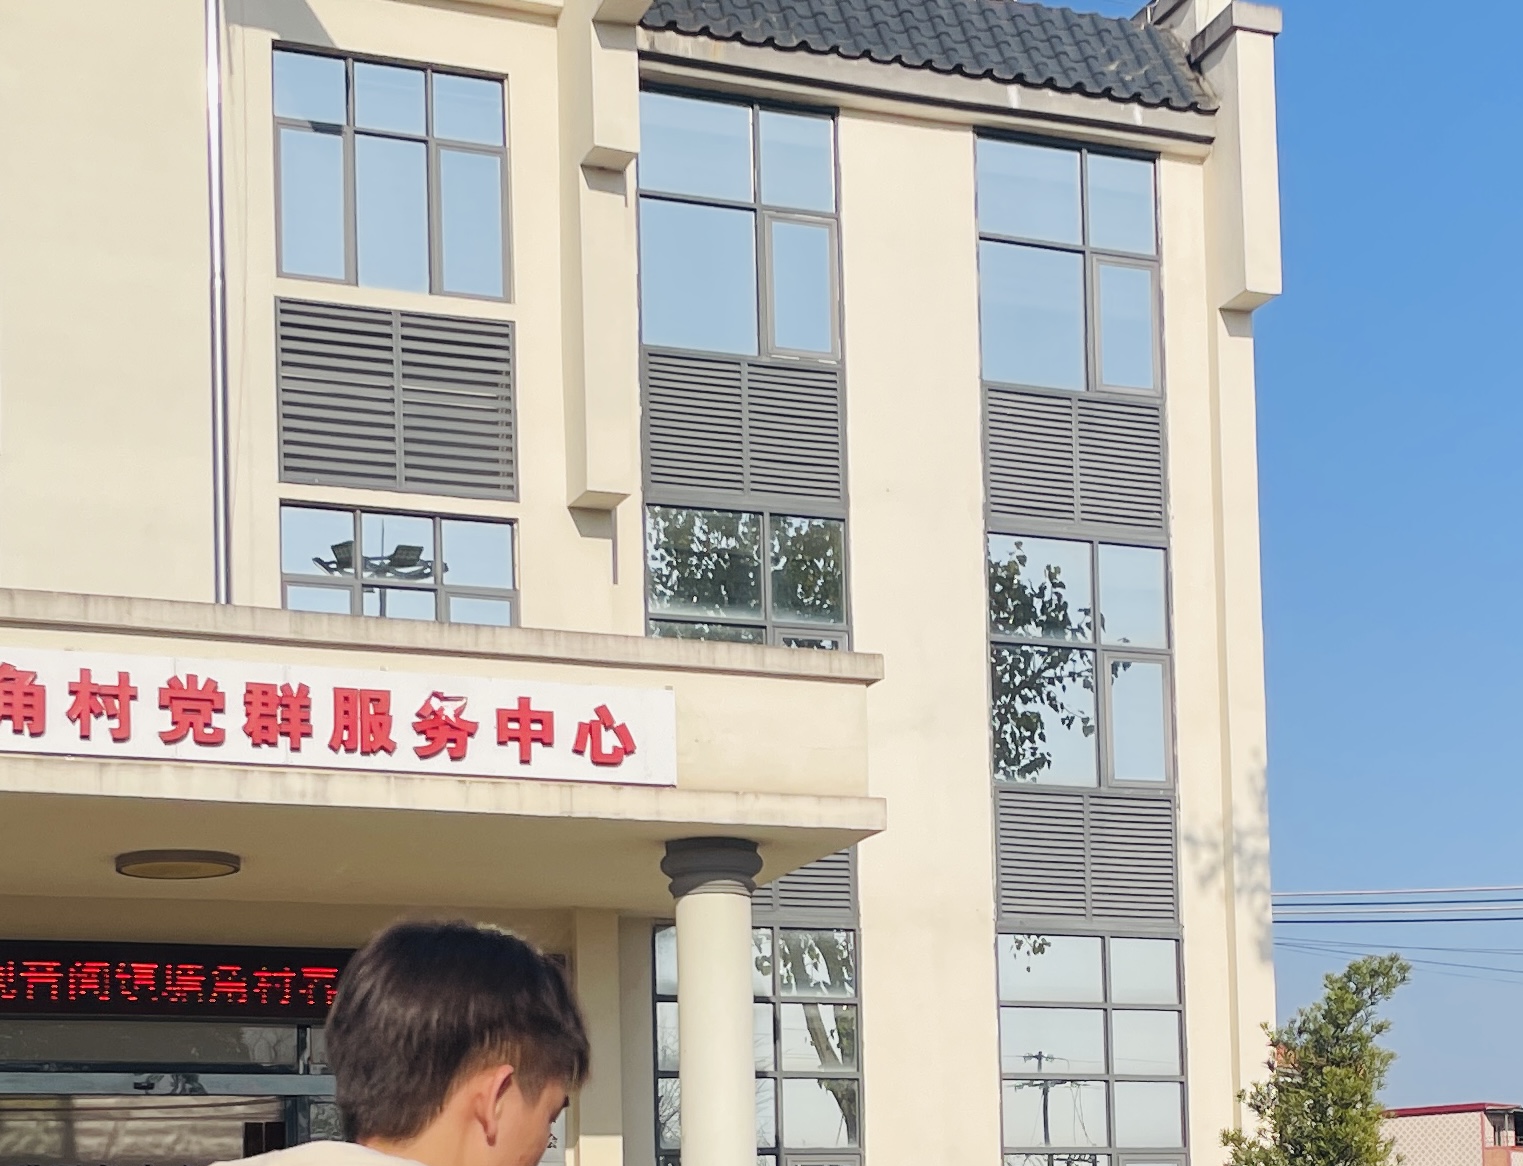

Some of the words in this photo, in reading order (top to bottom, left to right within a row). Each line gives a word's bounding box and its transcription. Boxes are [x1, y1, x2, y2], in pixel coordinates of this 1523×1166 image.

[0, 661, 638, 768] 角村党群服务中心
